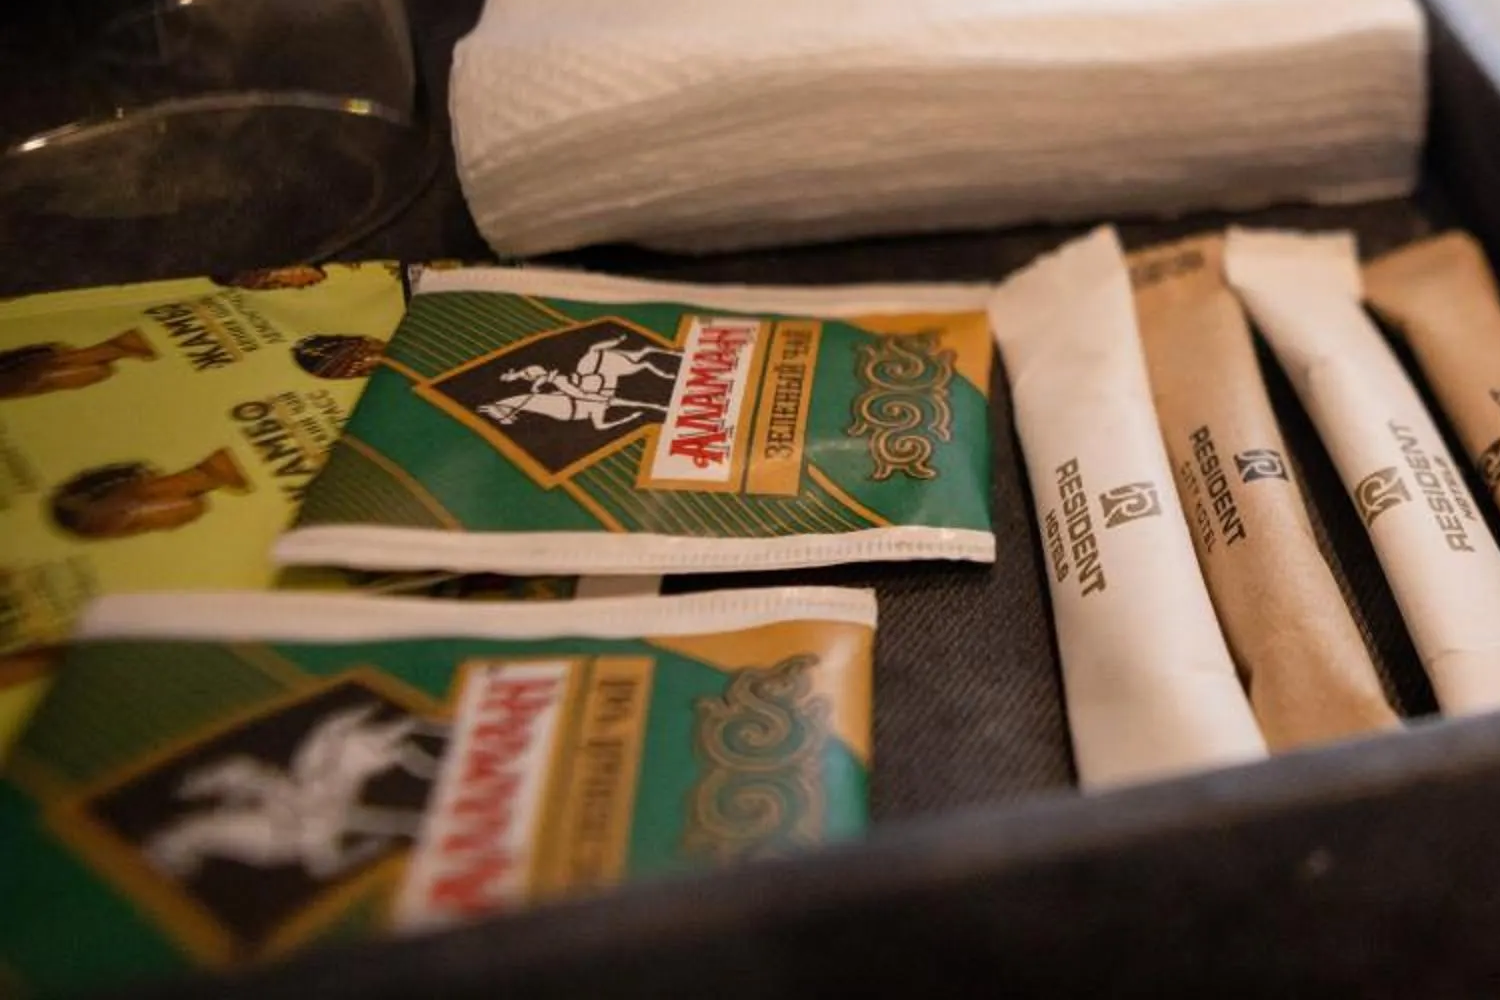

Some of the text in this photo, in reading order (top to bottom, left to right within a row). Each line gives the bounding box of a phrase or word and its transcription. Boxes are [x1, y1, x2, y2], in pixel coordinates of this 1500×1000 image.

[1044, 507, 1069, 583] HOTELS
[1056, 457, 1107, 597] RESIDENT
[1189, 424, 1247, 546] RESIDENT
[1386, 418, 1476, 553] RESIDENT
